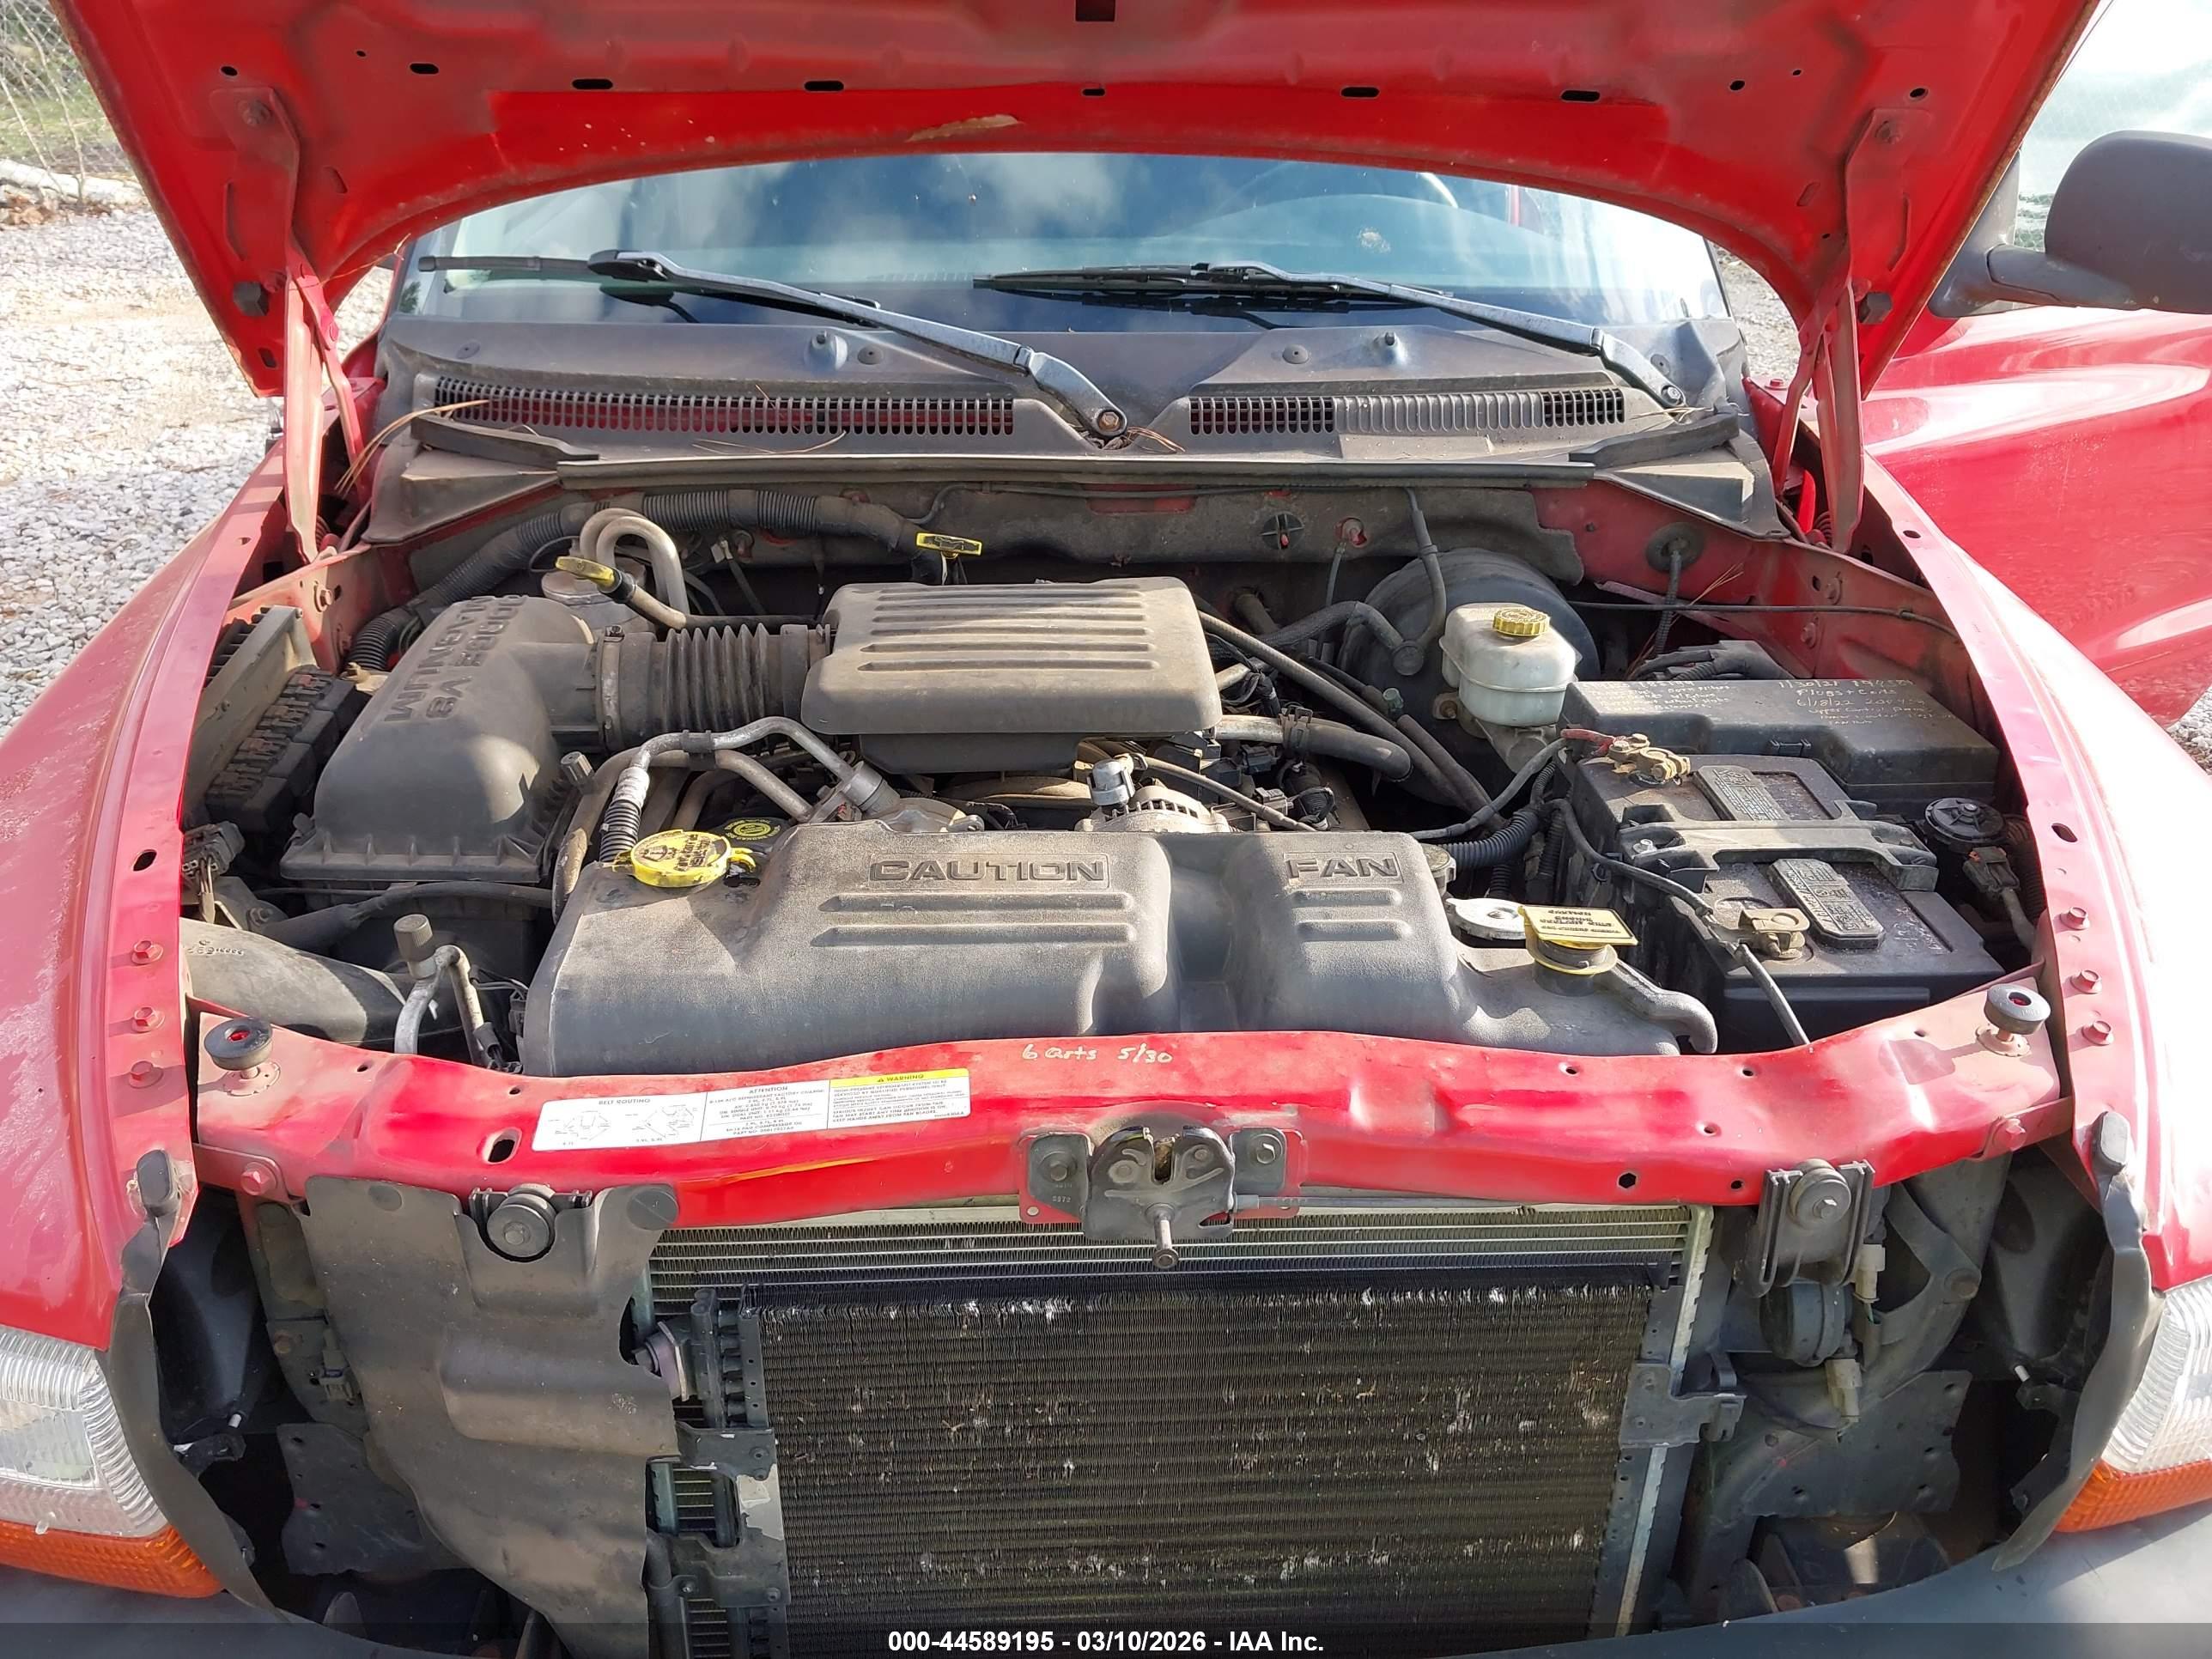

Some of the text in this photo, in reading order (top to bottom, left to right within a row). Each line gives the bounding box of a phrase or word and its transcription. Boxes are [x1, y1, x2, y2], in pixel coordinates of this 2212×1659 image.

[426, 675, 475, 719] V8
[869, 858, 1399, 882] CAUTION FAN
[1118, 1042, 1174, 1064] 5/30
